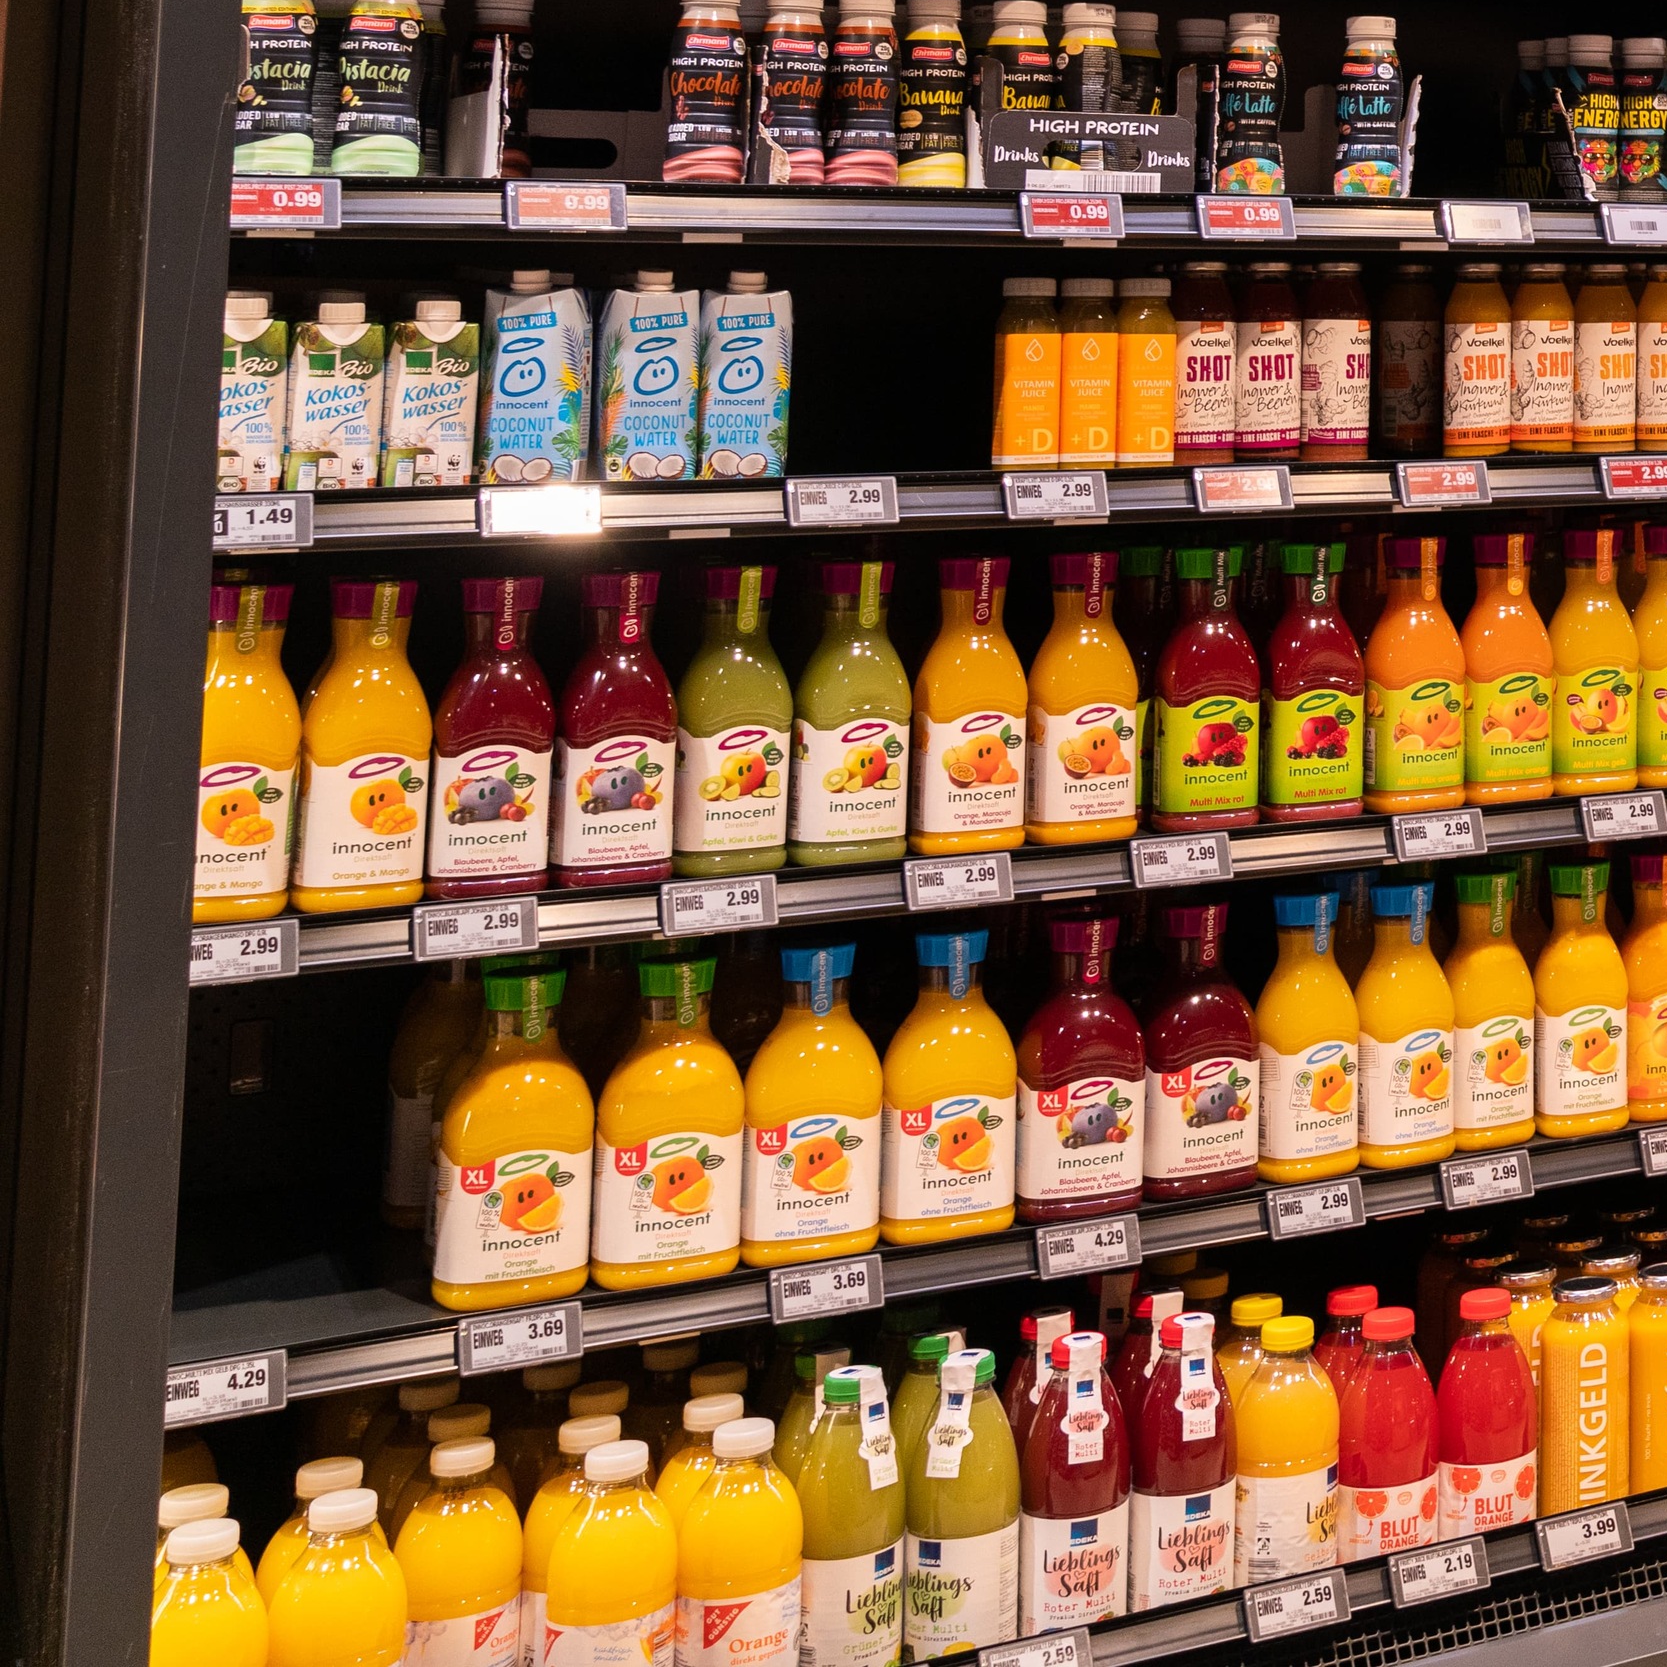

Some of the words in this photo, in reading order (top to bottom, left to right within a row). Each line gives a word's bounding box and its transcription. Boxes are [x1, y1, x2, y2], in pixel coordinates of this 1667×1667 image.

[250, 16, 294, 30] Ehrmann
[672, 57, 695, 66] HIGH
[700, 57, 743, 68] PROTEIN
[670, 73, 742, 96] Chocolate
[1029, 118, 1080, 133] HIGH
[1086, 120, 1160, 136] PROTEIN
[994, 146, 1039, 163] Drinks
[272, 191, 322, 208] 0.99
[502, 316, 526, 330] 100%
[529, 314, 553, 328] PURE
[1252, 337, 1293, 347] Voelkel
[340, 359, 375, 379] Bio
[1187, 354, 1232, 383] SHOT
[1249, 354, 1294, 382] SHOT
[305, 379, 372, 407] Kokos-
[1013, 380, 1055, 389] VITAMIN
[1021, 389, 1047, 398] JUICE
[305, 397, 371, 422] wasser
[495, 401, 548, 410] innocent
[490, 416, 554, 433] COCONUT
[499, 433, 543, 450] WATER
[800, 490, 827, 506] EINWEG
[1016, 484, 1043, 499] EINWEG
[1062, 483, 1092, 497] 2.99
[246, 507, 293, 525] 1.49
[1189, 798, 1213, 807] Multi
[1214, 797, 1231, 805] Mix
[1232, 795, 1245, 803] rot
[332, 839, 412, 854] innocent
[332, 872, 367, 882] Orange
[379, 867, 410, 879] Mango
[427, 917, 459, 937] EINWEG
[483, 913, 519, 930] 2.99
[465, 1169, 489, 1185] XL
[482, 1232, 561, 1251] innocent
[484, 1269, 500, 1280] mit
[501, 1264, 556, 1279] Fruchtfleisch
[504, 1258, 538, 1269] Orange
[165, 1381, 200, 1401] EINWEG
[227, 1371, 266, 1390] 4.29
[1474, 1497, 1514, 1516] BLUT
[1474, 1509, 1515, 1527] ORANGE
[1582, 1516, 1616, 1538] 3.99
[1042, 1544, 1121, 1574] Lieblings
[1402, 1561, 1427, 1582] EINWEG
[1443, 1552, 1473, 1573] 2.19
[1058, 1567, 1100, 1598] Saft
[1043, 1602, 1078, 1613] Roter
[1085, 1591, 1116, 1608] Multi
